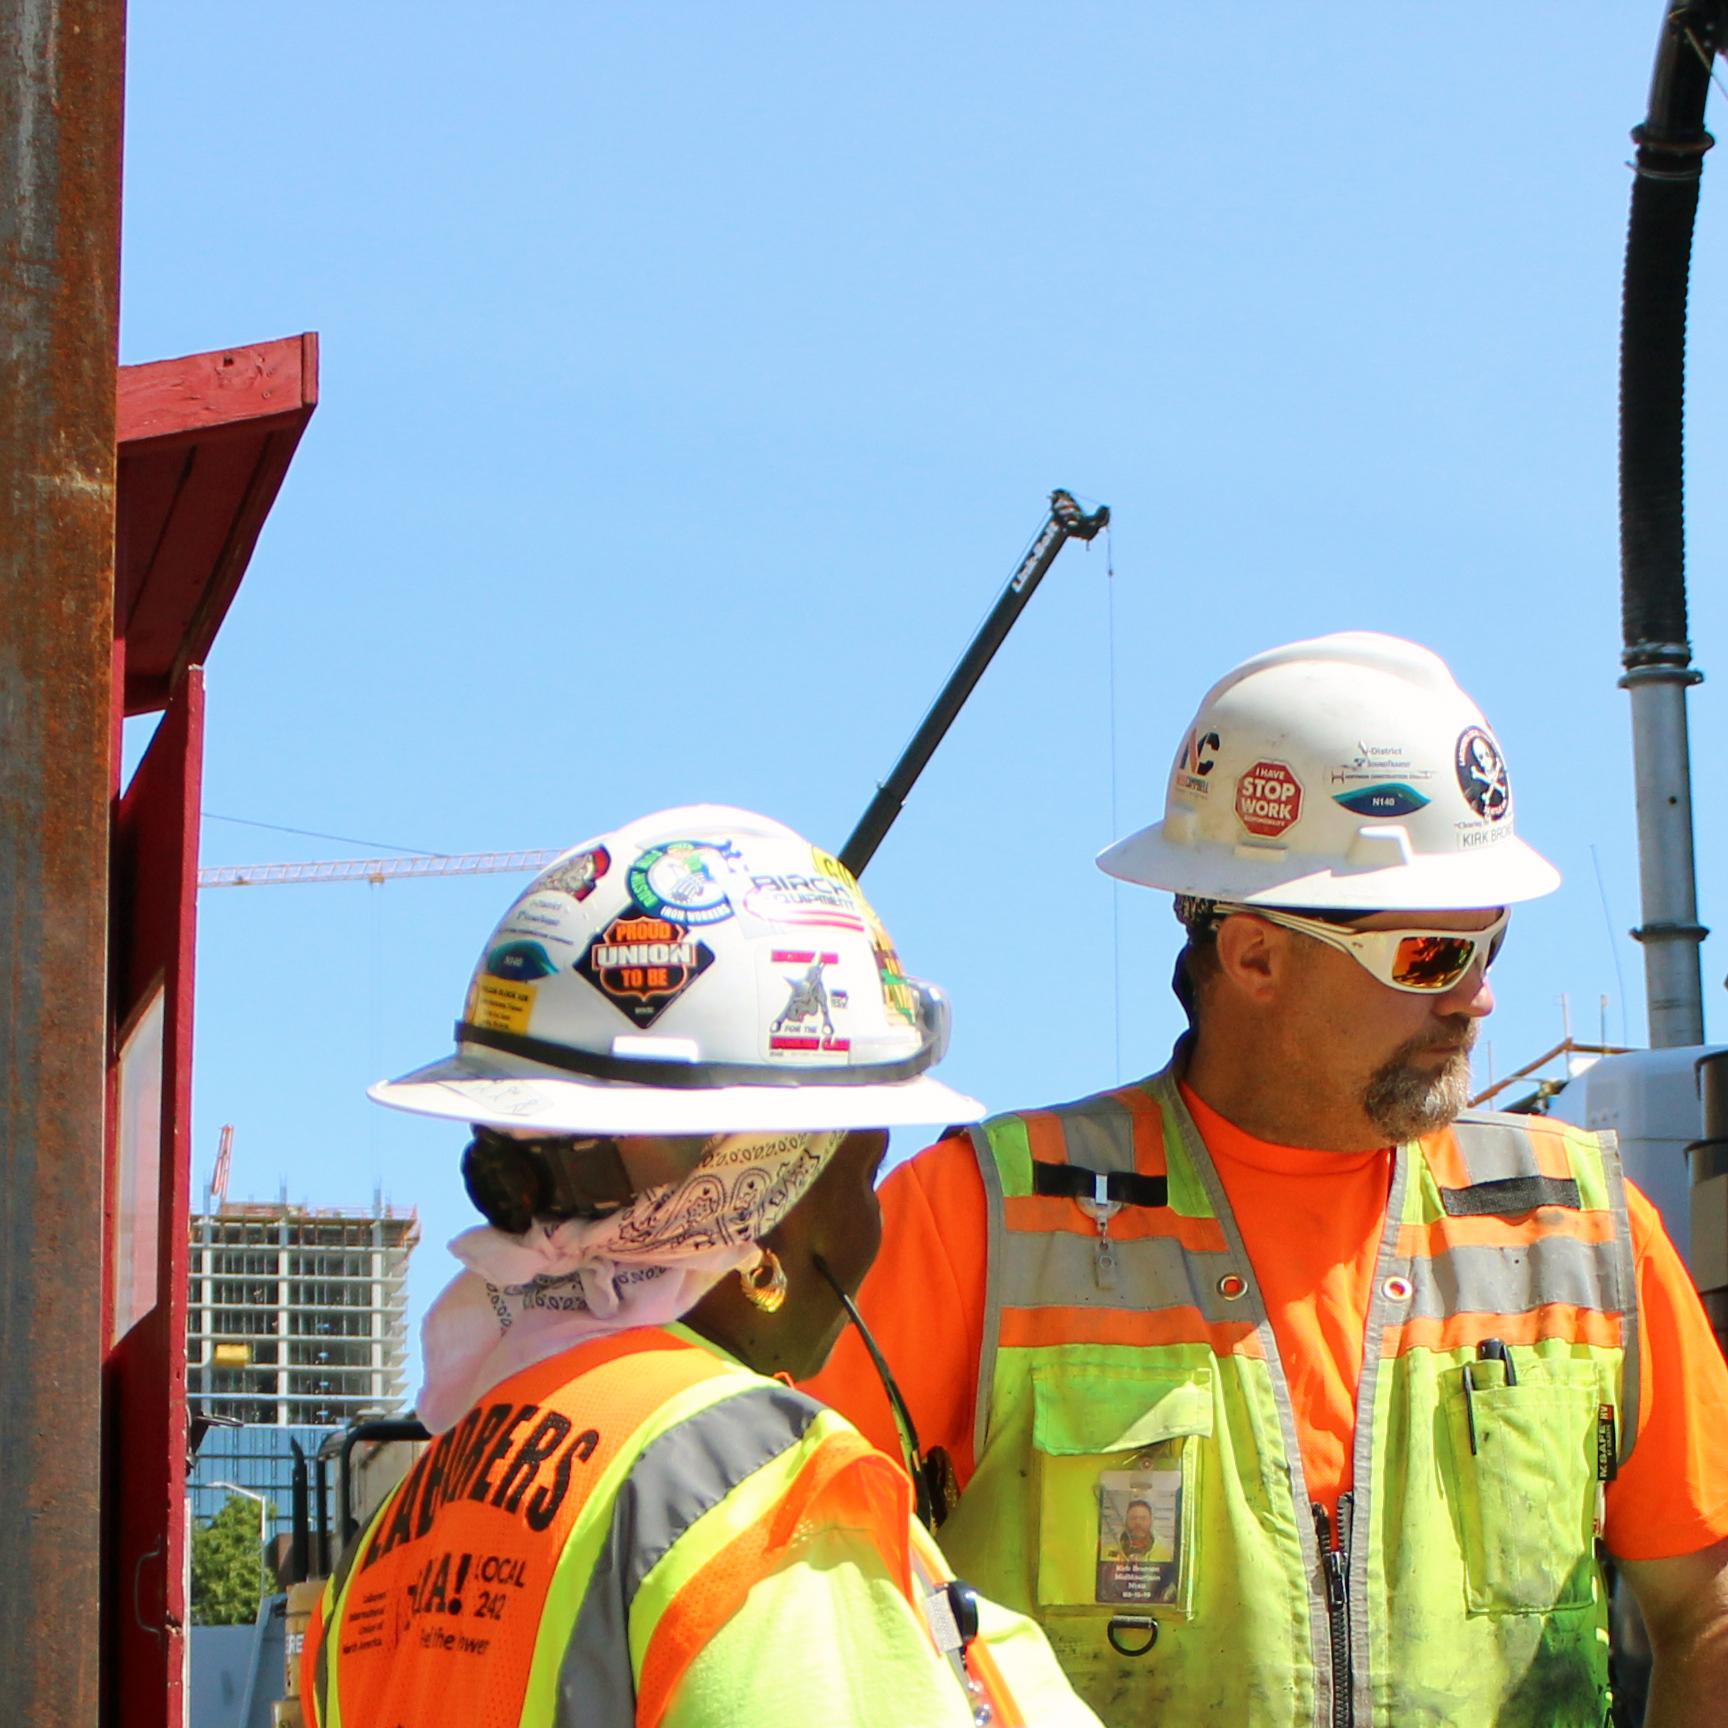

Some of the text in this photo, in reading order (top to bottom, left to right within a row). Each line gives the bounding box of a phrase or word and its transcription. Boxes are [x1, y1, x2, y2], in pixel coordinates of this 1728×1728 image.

[1260, 768, 1286, 780] HAVE
[1242, 777, 1295, 801] STOP
[1241, 797, 1292, 820] WORK
[1462, 831, 1490, 848] KIRK
[750, 874, 852, 899] BIRCH
[780, 893, 857, 911] QUIPMENT
[616, 921, 671, 940] PROUD
[597, 943, 692, 967] UNION
[621, 968, 669, 987] TO BE
